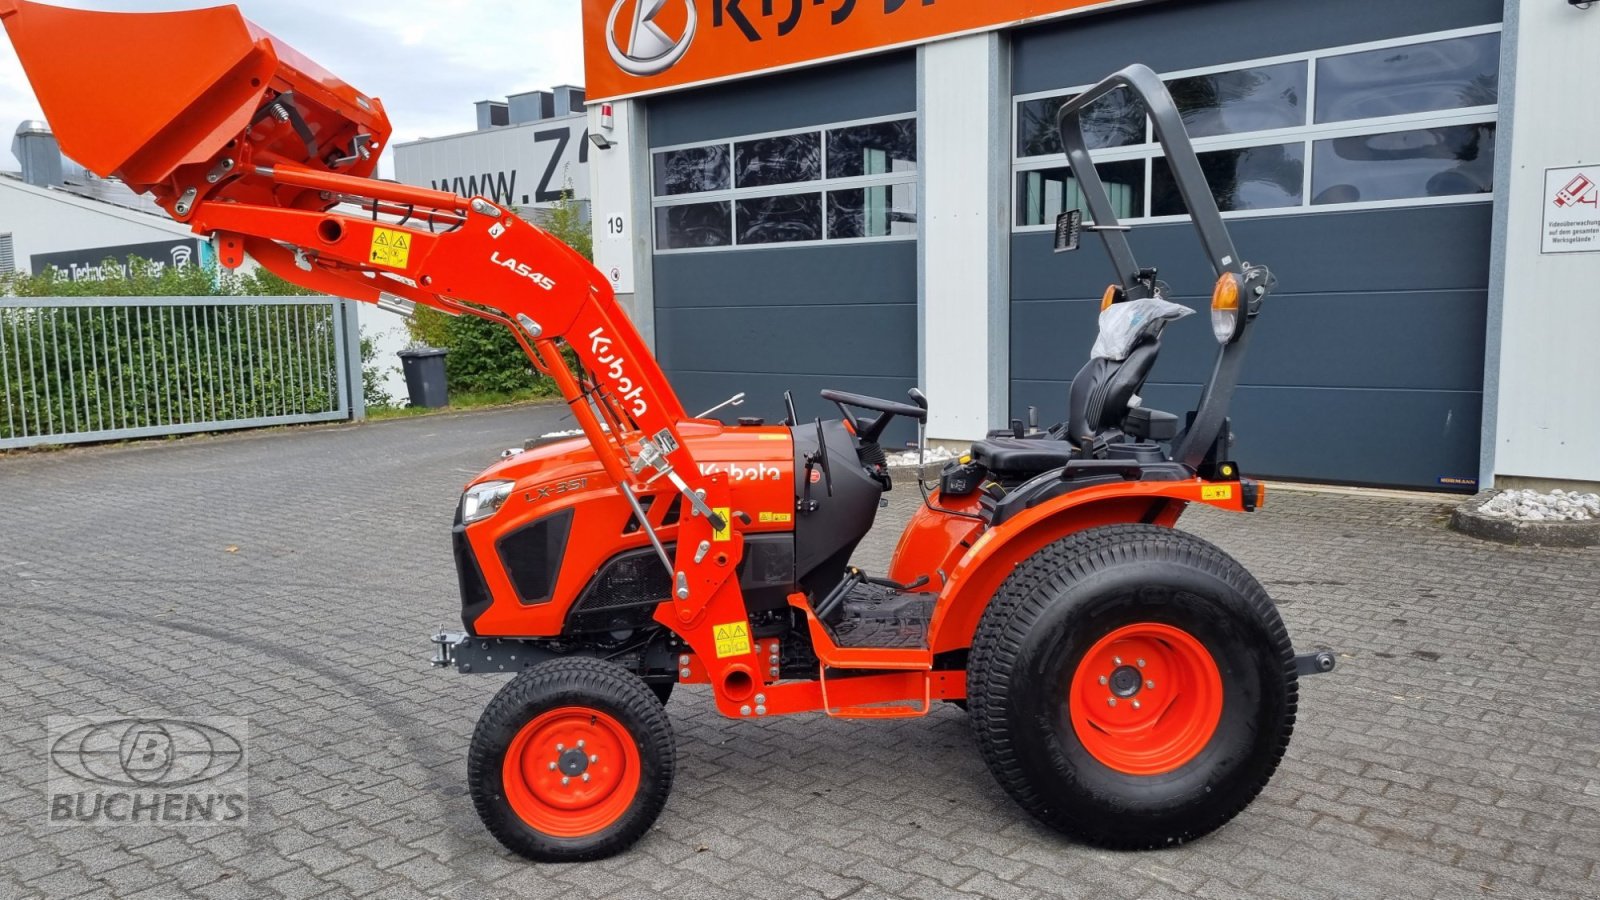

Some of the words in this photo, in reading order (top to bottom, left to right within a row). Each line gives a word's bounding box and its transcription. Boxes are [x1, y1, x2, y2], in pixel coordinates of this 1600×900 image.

[608, 217, 623, 234] 19
[490, 251, 556, 291] LA545
[588, 327, 647, 417] Kubota
